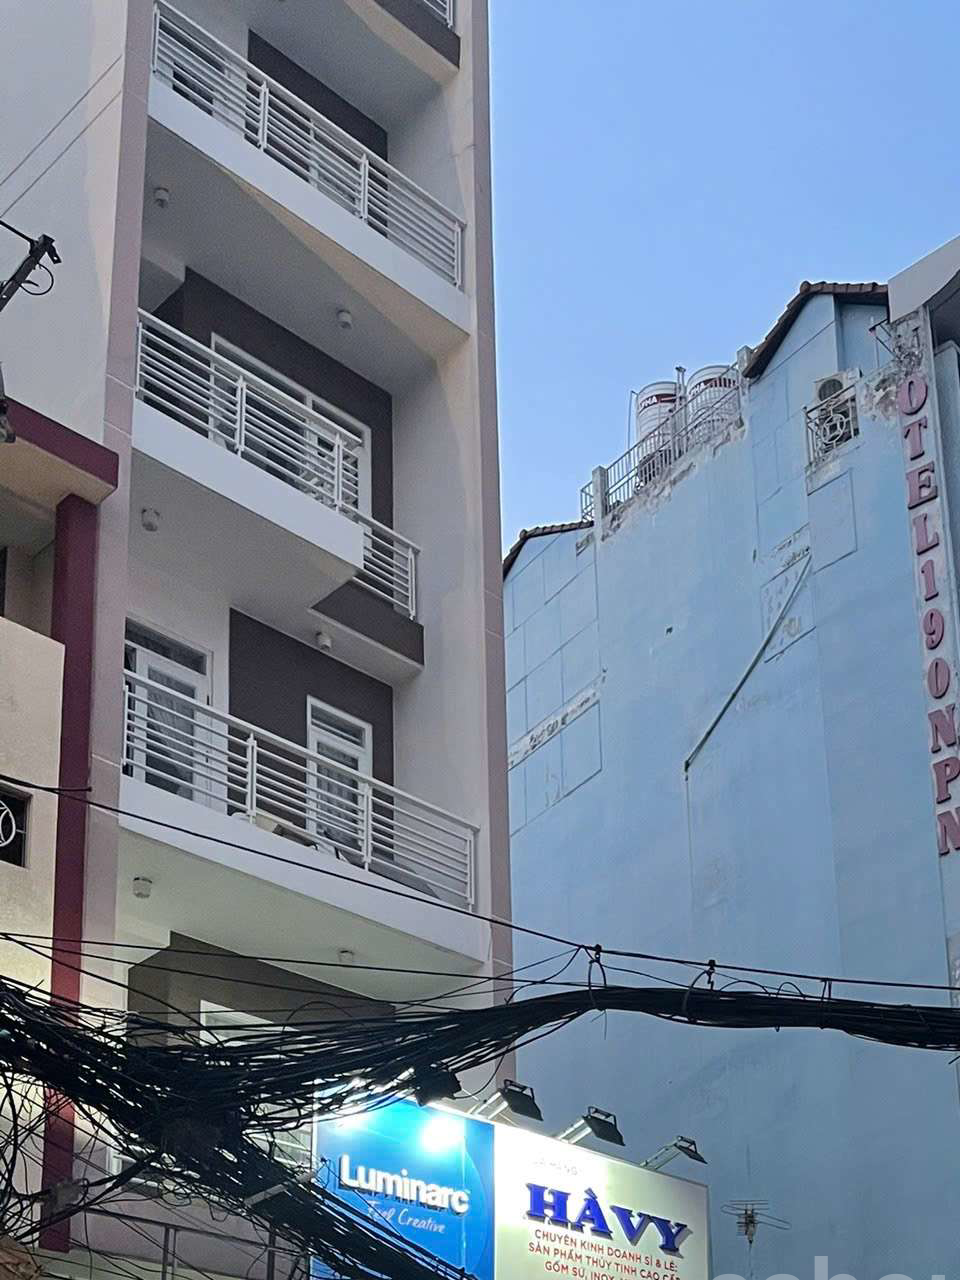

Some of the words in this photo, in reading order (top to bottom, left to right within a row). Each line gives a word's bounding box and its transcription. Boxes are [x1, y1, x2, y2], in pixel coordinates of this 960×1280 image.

[339, 1154, 471, 1215] Luminarc
[397, 1208, 446, 1234] Creative
[580, 1240, 604, 1254] KINH
[608, 1247, 641, 1263] DOANH
[614, 1262, 637, 1276] TINH
[640, 1269, 660, 1280] CAO
